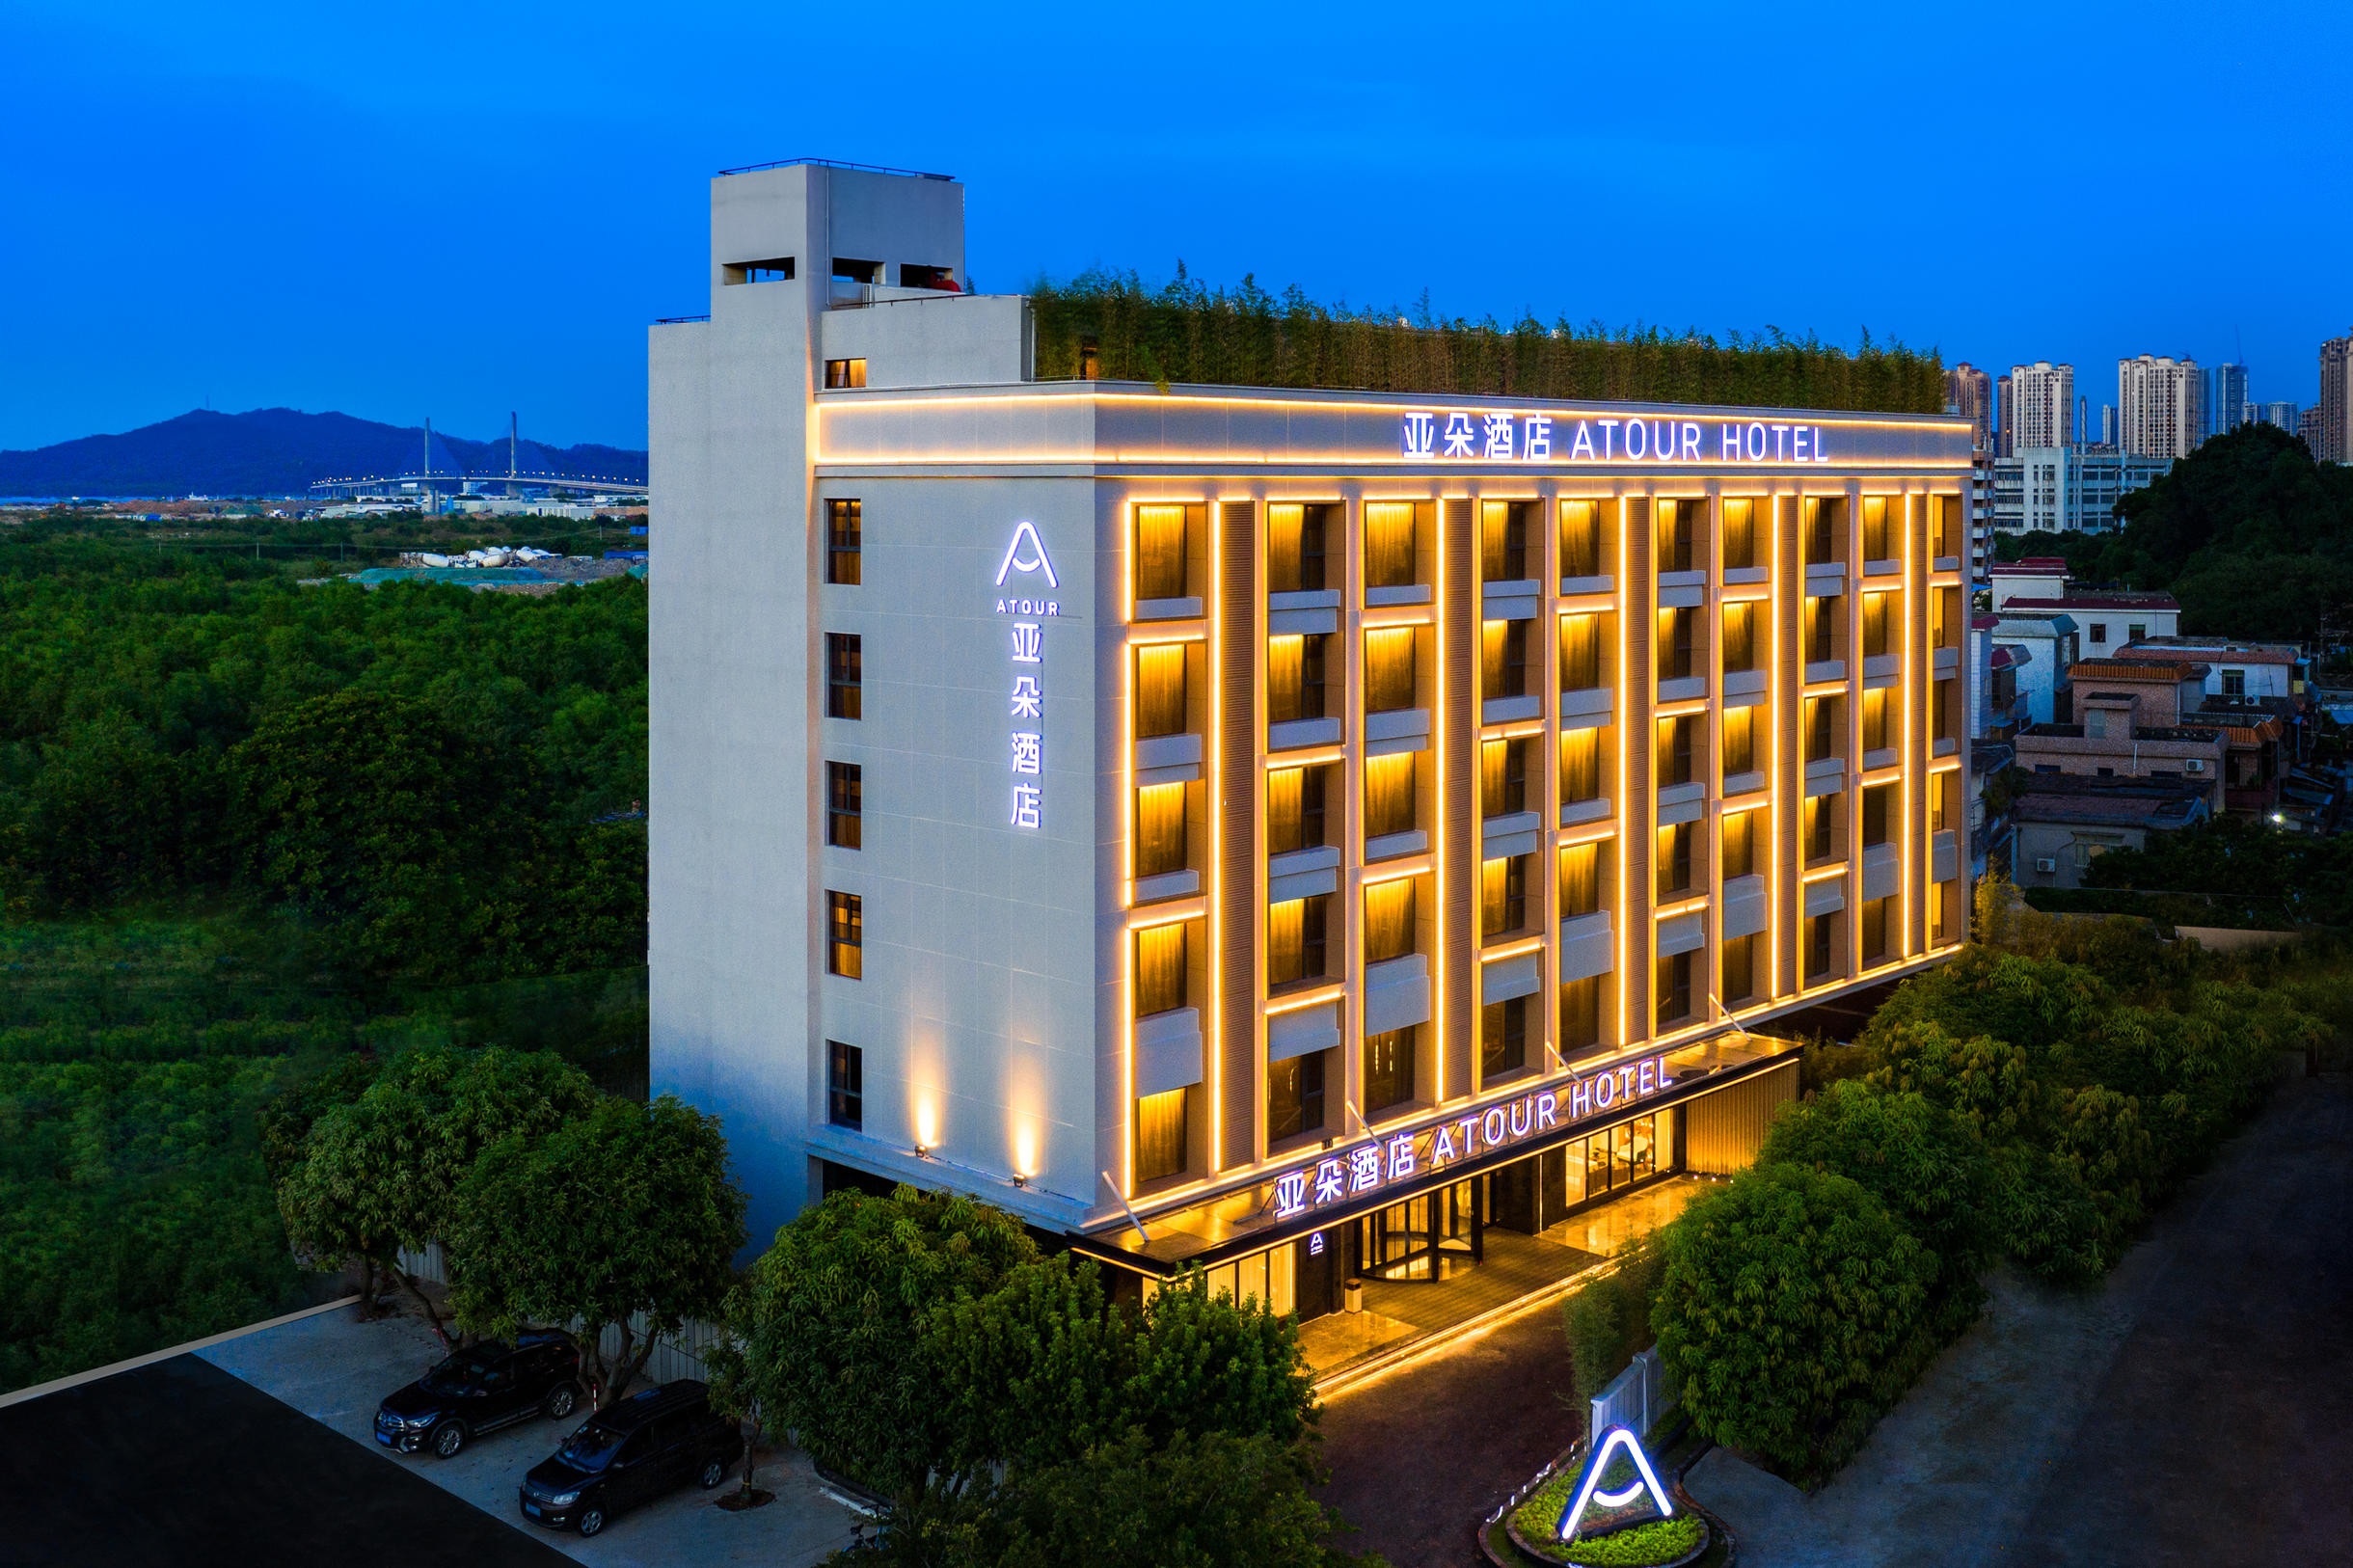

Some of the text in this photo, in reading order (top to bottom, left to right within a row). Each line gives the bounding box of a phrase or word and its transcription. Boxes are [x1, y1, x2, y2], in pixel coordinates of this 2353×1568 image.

[1403, 412, 1828, 463] 亚朵酒店 ATOUR HOTEL
[996, 599, 1061, 616] ATOUR
[1011, 622, 1042, 829] 亚朵酒店
[1275, 1056, 1673, 1218] 亚朵酒店 ATOUR HOTEL
